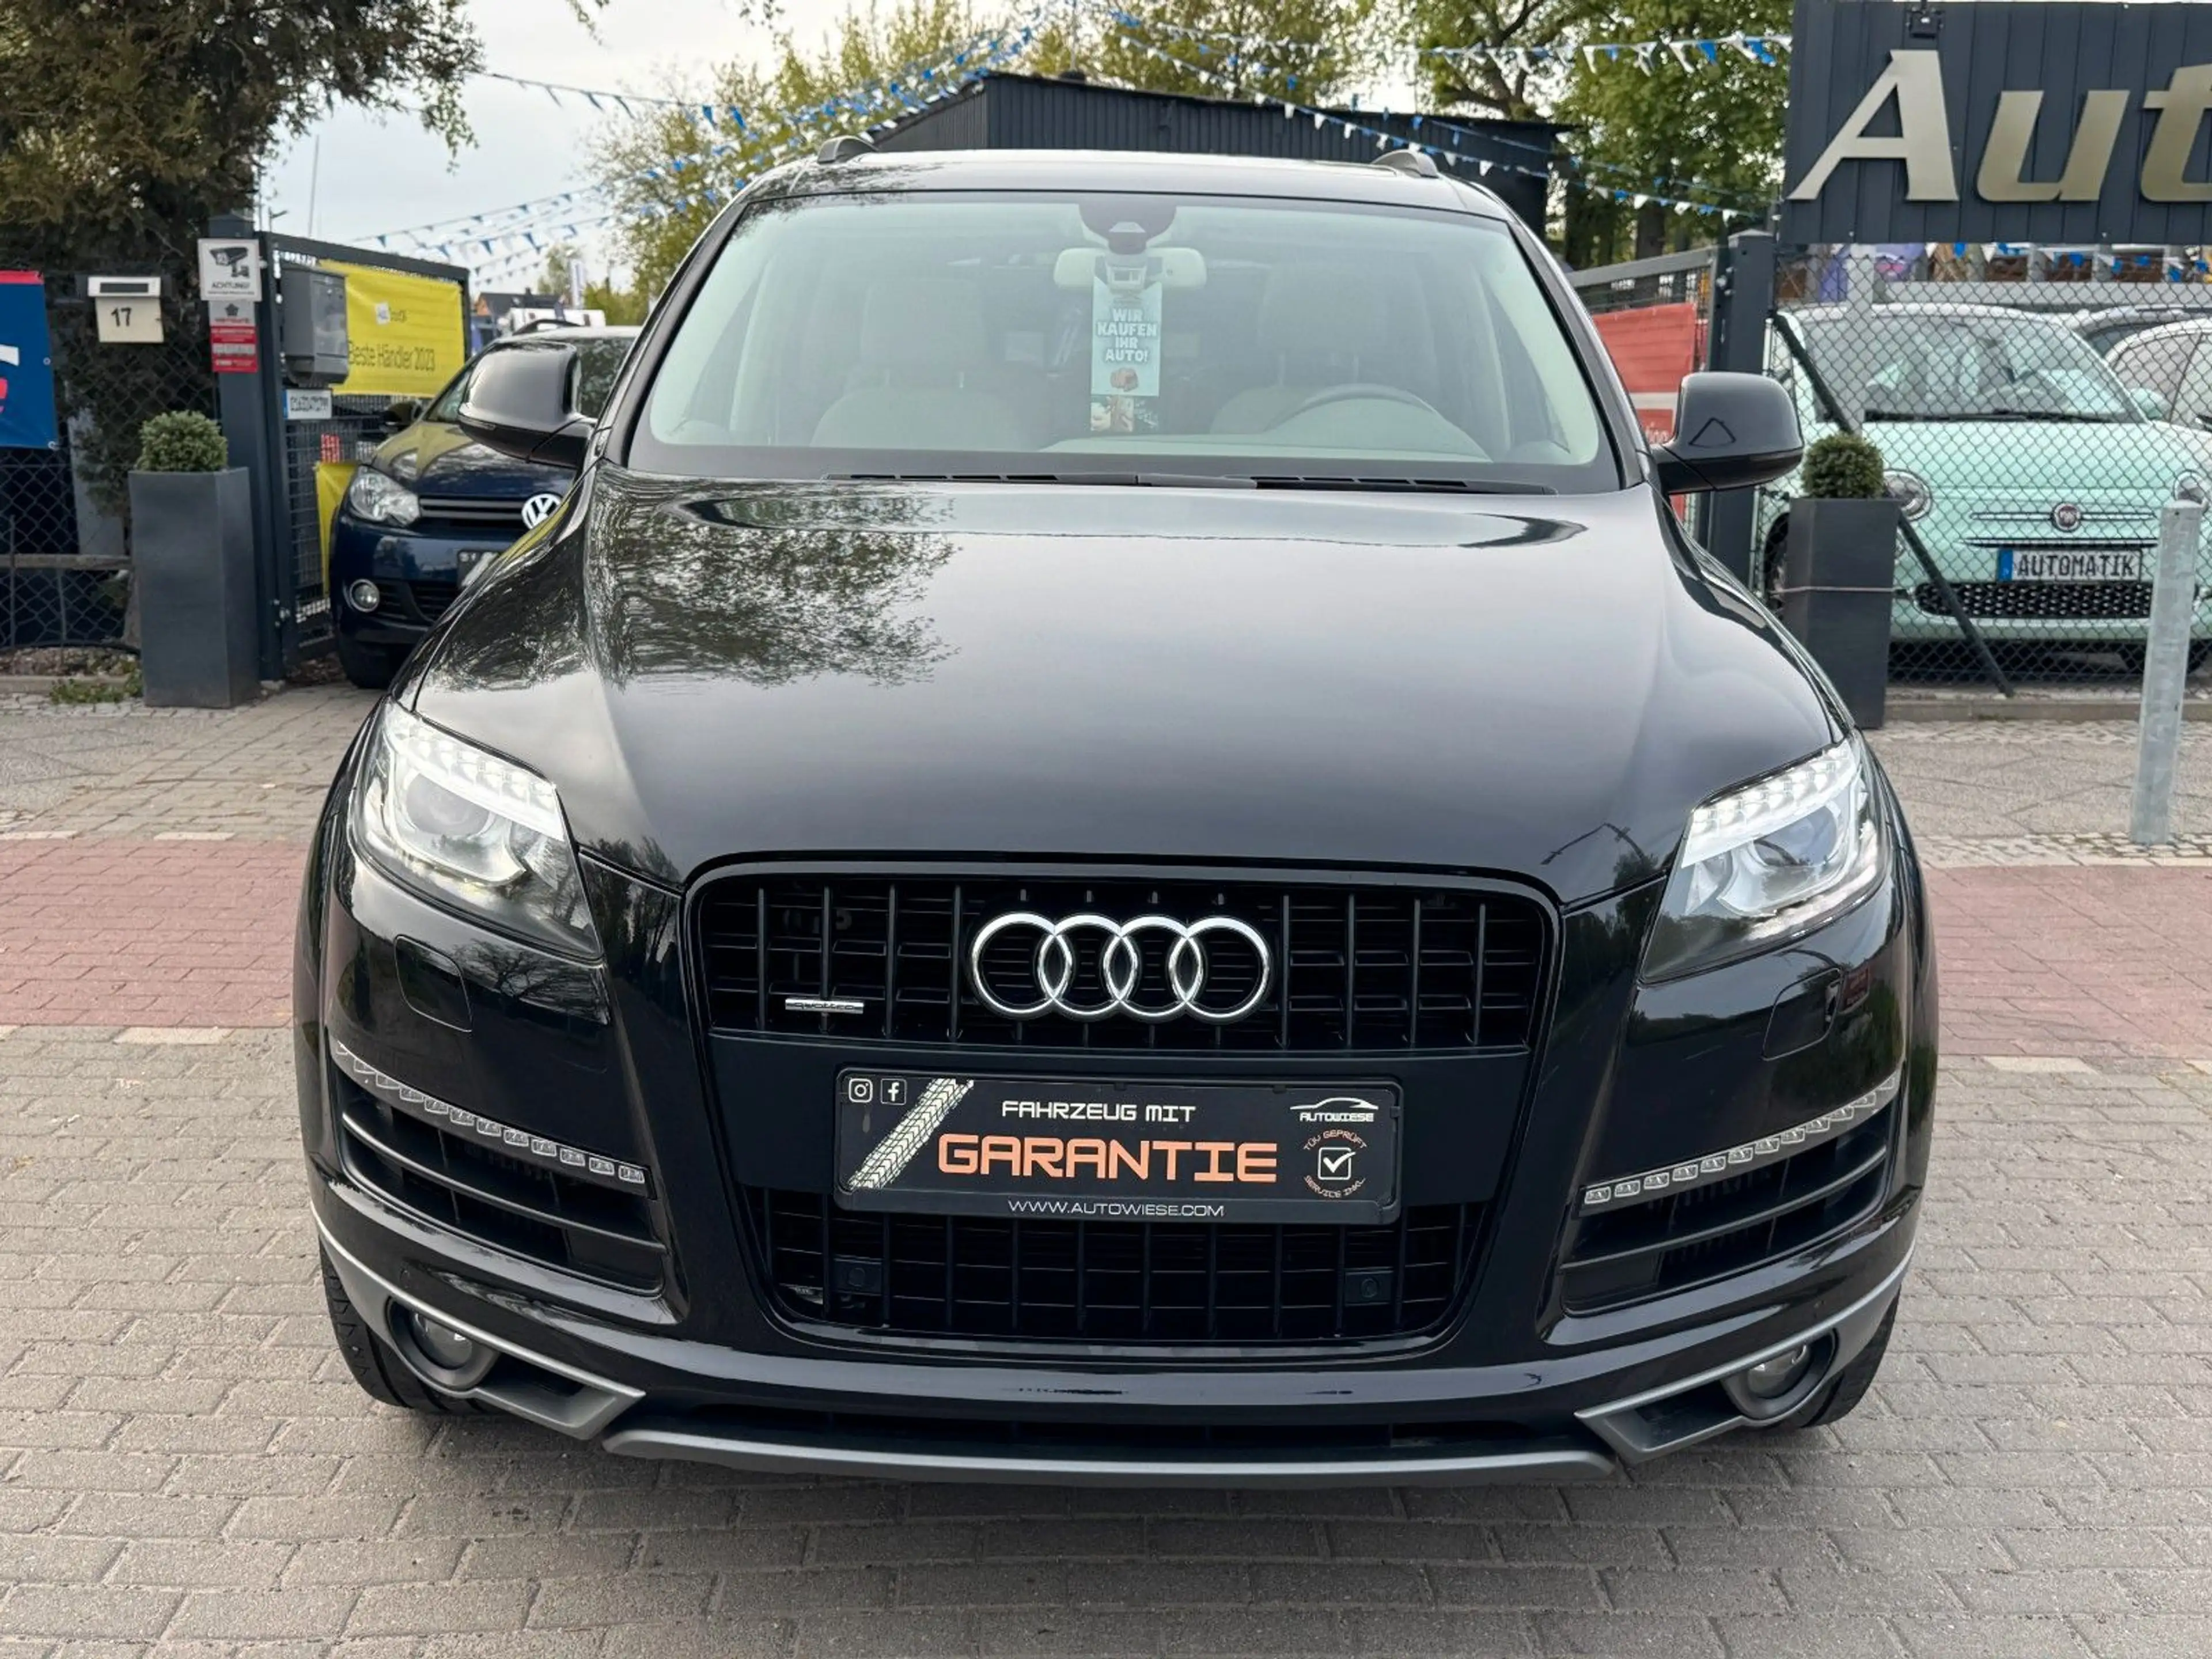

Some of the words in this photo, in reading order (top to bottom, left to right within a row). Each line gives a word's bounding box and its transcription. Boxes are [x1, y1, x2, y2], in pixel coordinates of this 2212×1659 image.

[1787, 50, 2212, 203] Aut
[111, 307, 132, 327] 17
[1112, 308, 1143, 322] WIR
[1097, 321, 1157, 336] KAUFEN
[1115, 335, 1138, 349] IHR
[1105, 349, 1149, 363] AUTO!
[2017, 554, 2135, 577] AUTOMATIK
[794, 1001, 855, 1010] quattro
[1002, 1100, 1137, 1122] FAHRZEUG
[1145, 1104, 1196, 1123] MIT
[1300, 1112, 1374, 1122] AUTOWIESE
[1323, 1129, 1368, 1149] GEPRÜFT
[938, 1133, 1278, 1183] GARANTIE
[1304, 1175, 1342, 1198] SERVICE
[1007, 1199, 1226, 1217] WWW.AUTOWIESE.COM
